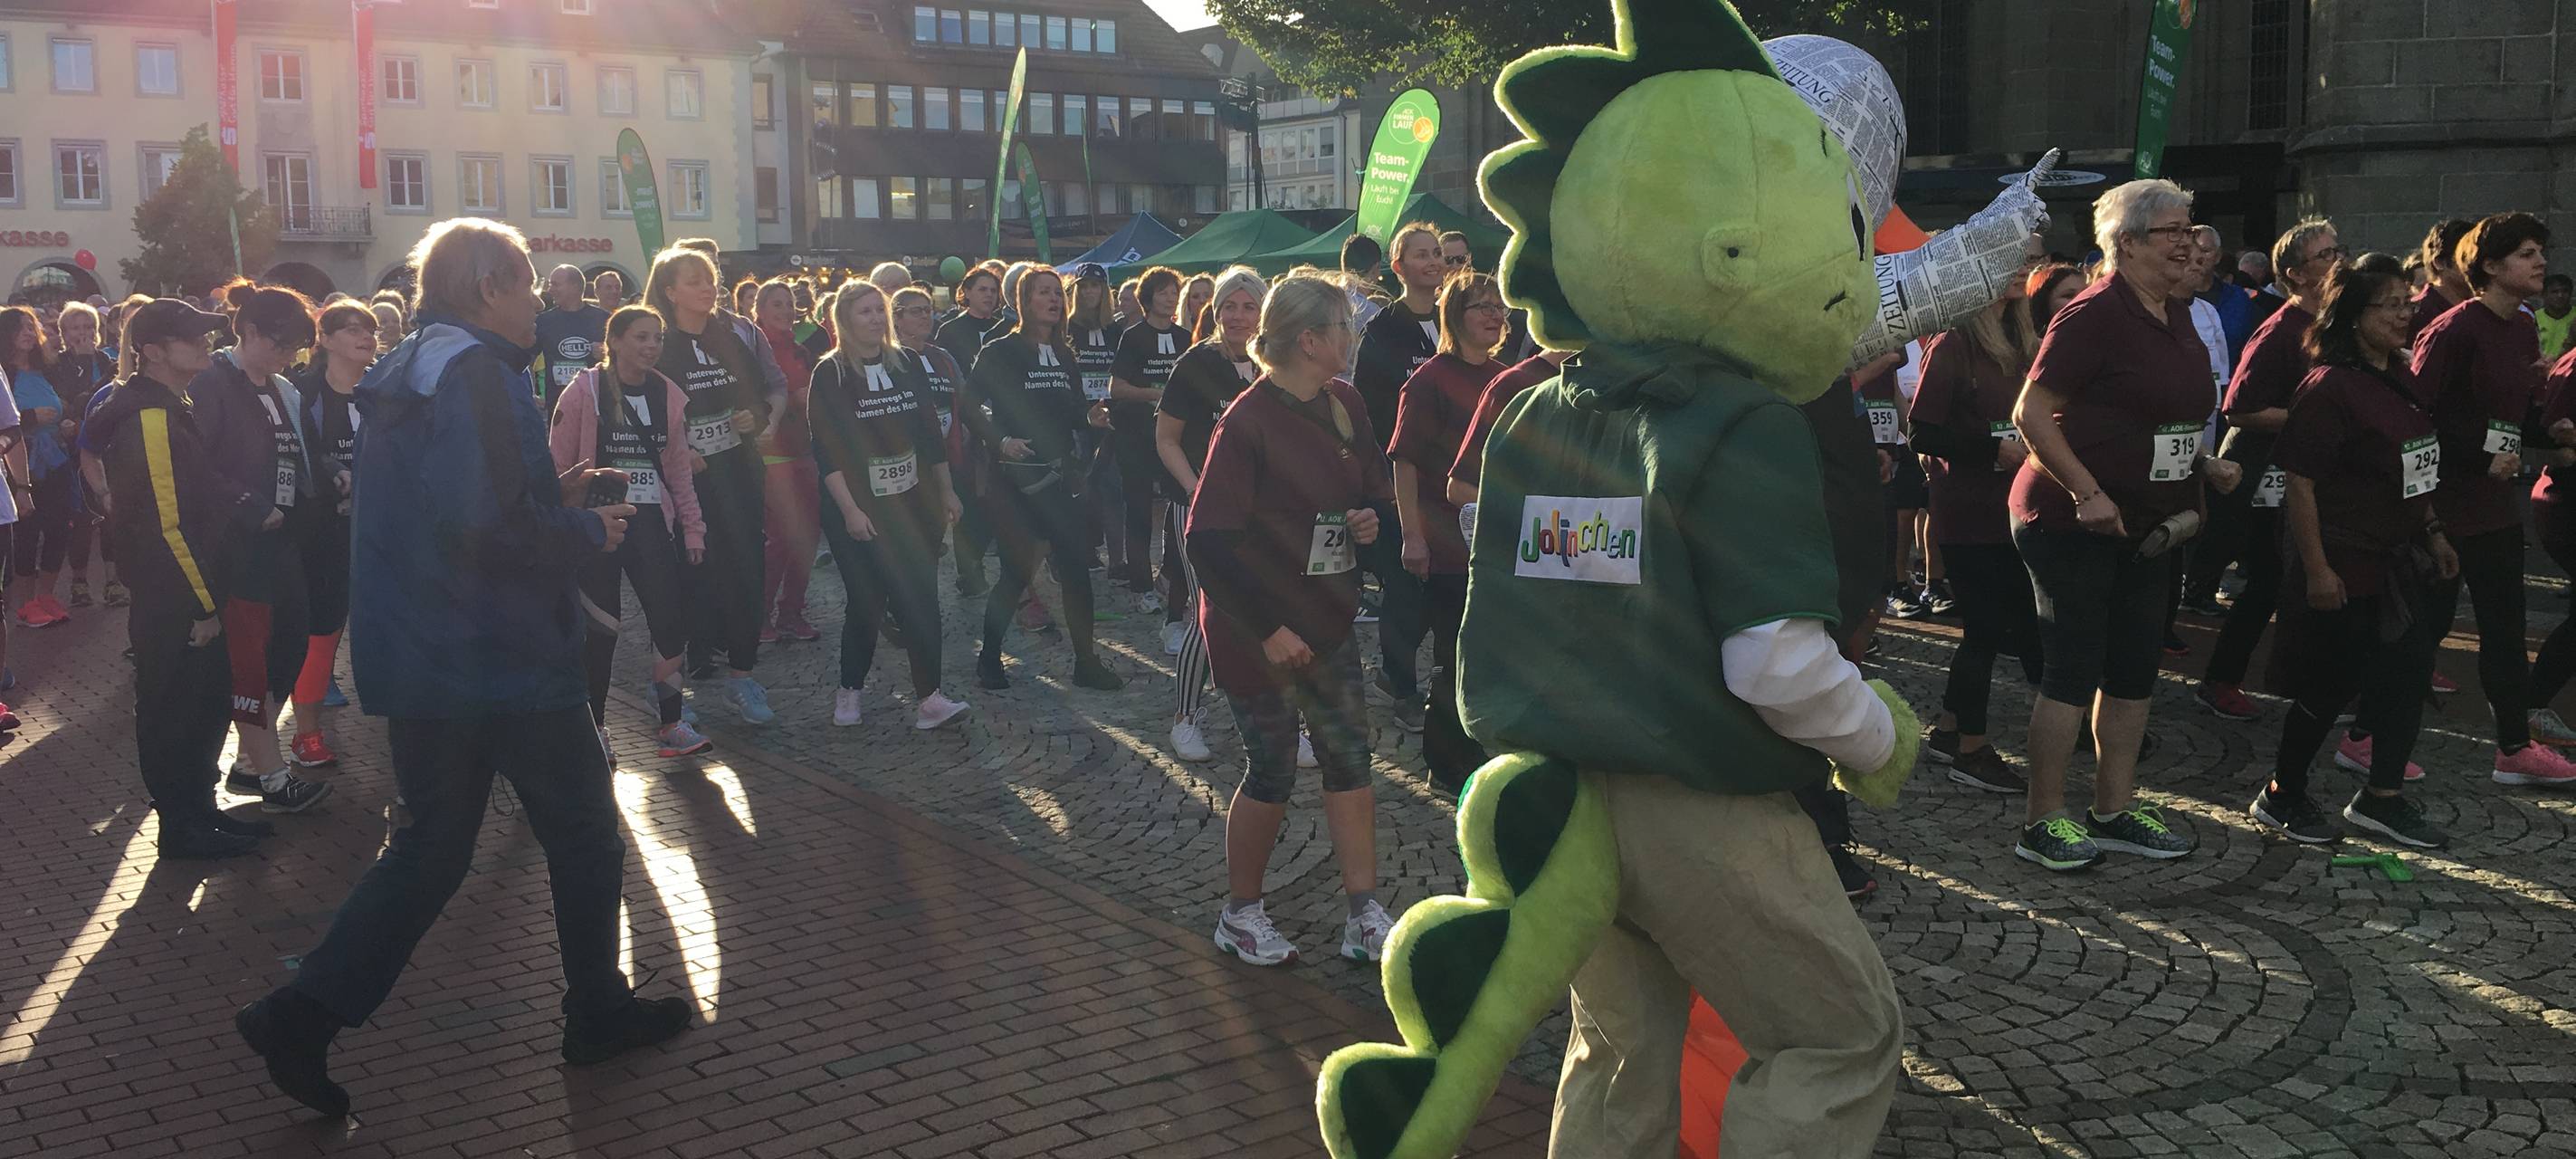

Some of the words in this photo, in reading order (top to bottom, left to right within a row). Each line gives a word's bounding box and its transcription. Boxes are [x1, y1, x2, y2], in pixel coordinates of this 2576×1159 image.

[2151, 34, 2176, 62] Team-
[2149, 58, 2175, 89] Power.
[1392, 120, 1413, 129] LAUF
[1374, 152, 1409, 166] Team-
[1371, 168, 1410, 184] Power.
[1875, 254, 1906, 336] ZEITUNG
[1025, 381, 1051, 390] Namen
[858, 393, 902, 408] Unterwegs
[887, 405, 902, 415] des
[1872, 411, 1893, 426] 359
[695, 421, 731, 441] 2913
[2171, 436, 2195, 456] 319
[2415, 448, 2439, 471] 292
[879, 461, 913, 480] 2898
